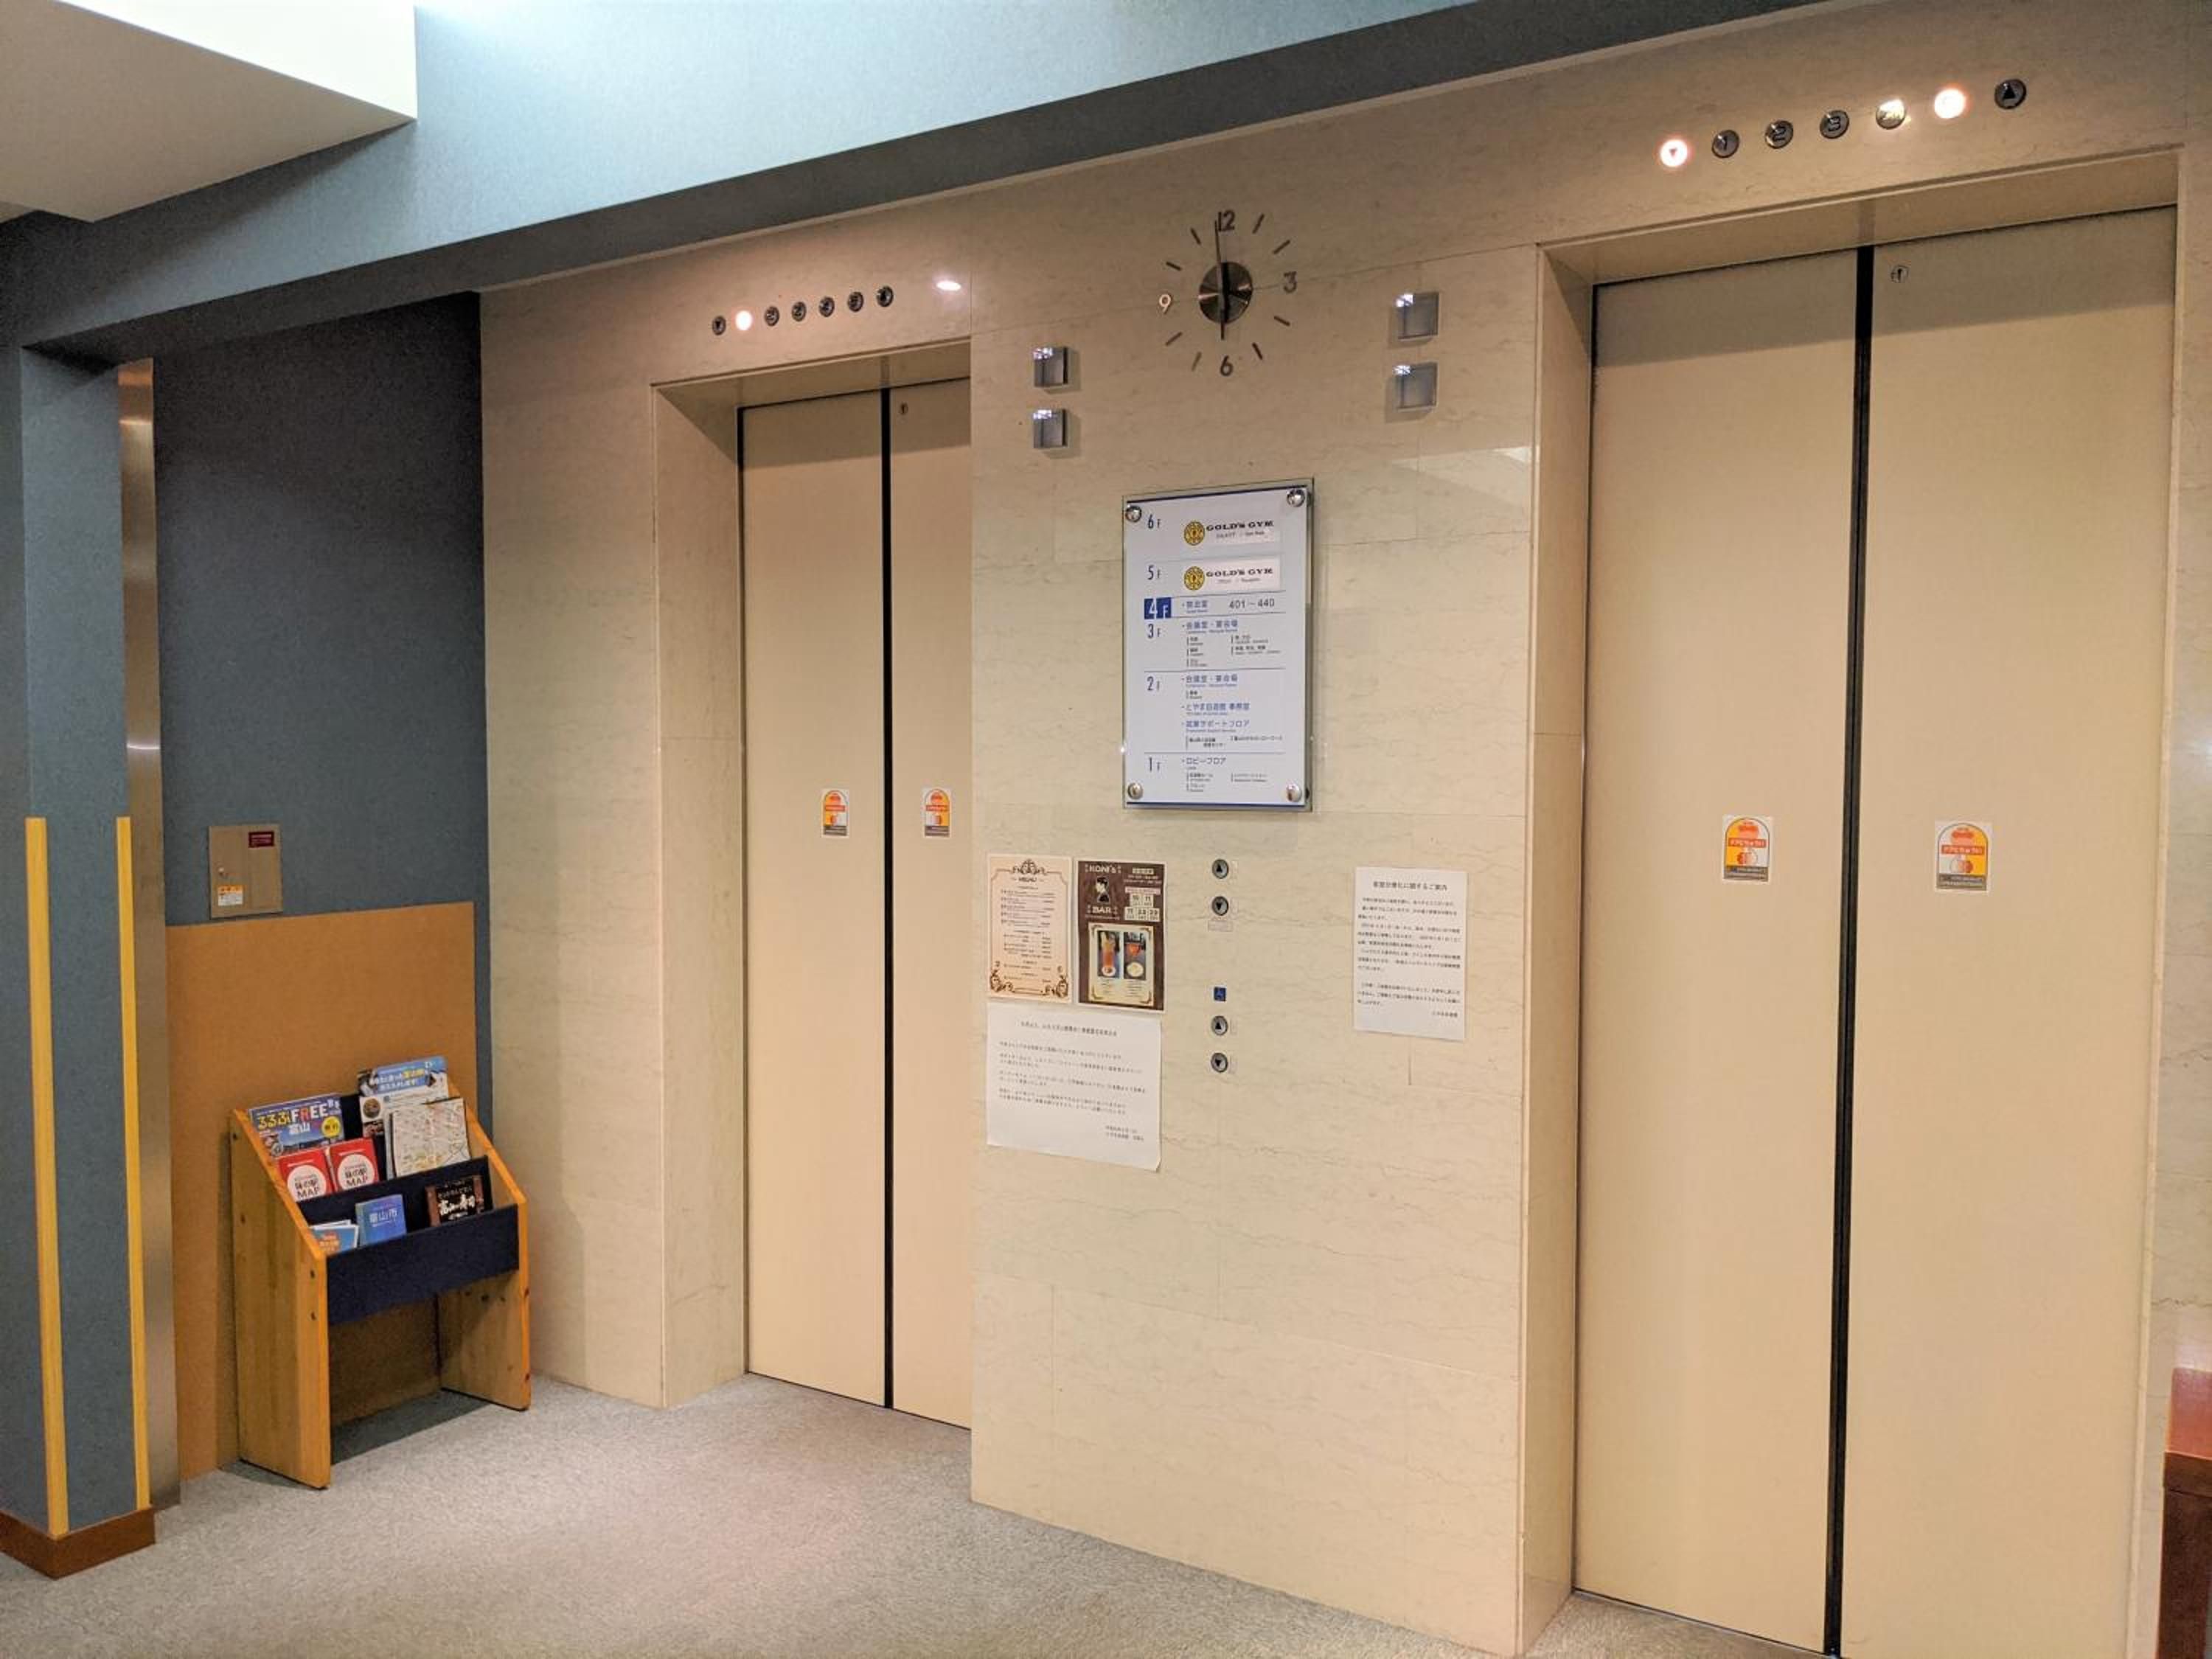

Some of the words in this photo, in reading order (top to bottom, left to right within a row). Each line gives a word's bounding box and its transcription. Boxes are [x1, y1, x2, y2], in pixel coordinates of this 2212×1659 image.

[1217, 209, 1236, 232] 12
[1284, 271, 1298, 293] 3
[1158, 293, 1172, 315] 9
[1220, 355, 1234, 377] 6
[1248, 520, 1275, 529] GYM
[1147, 598, 1169, 619] 4F
[346, 1175, 369, 1186] MAP
[297, 1186, 319, 1197] MAP
